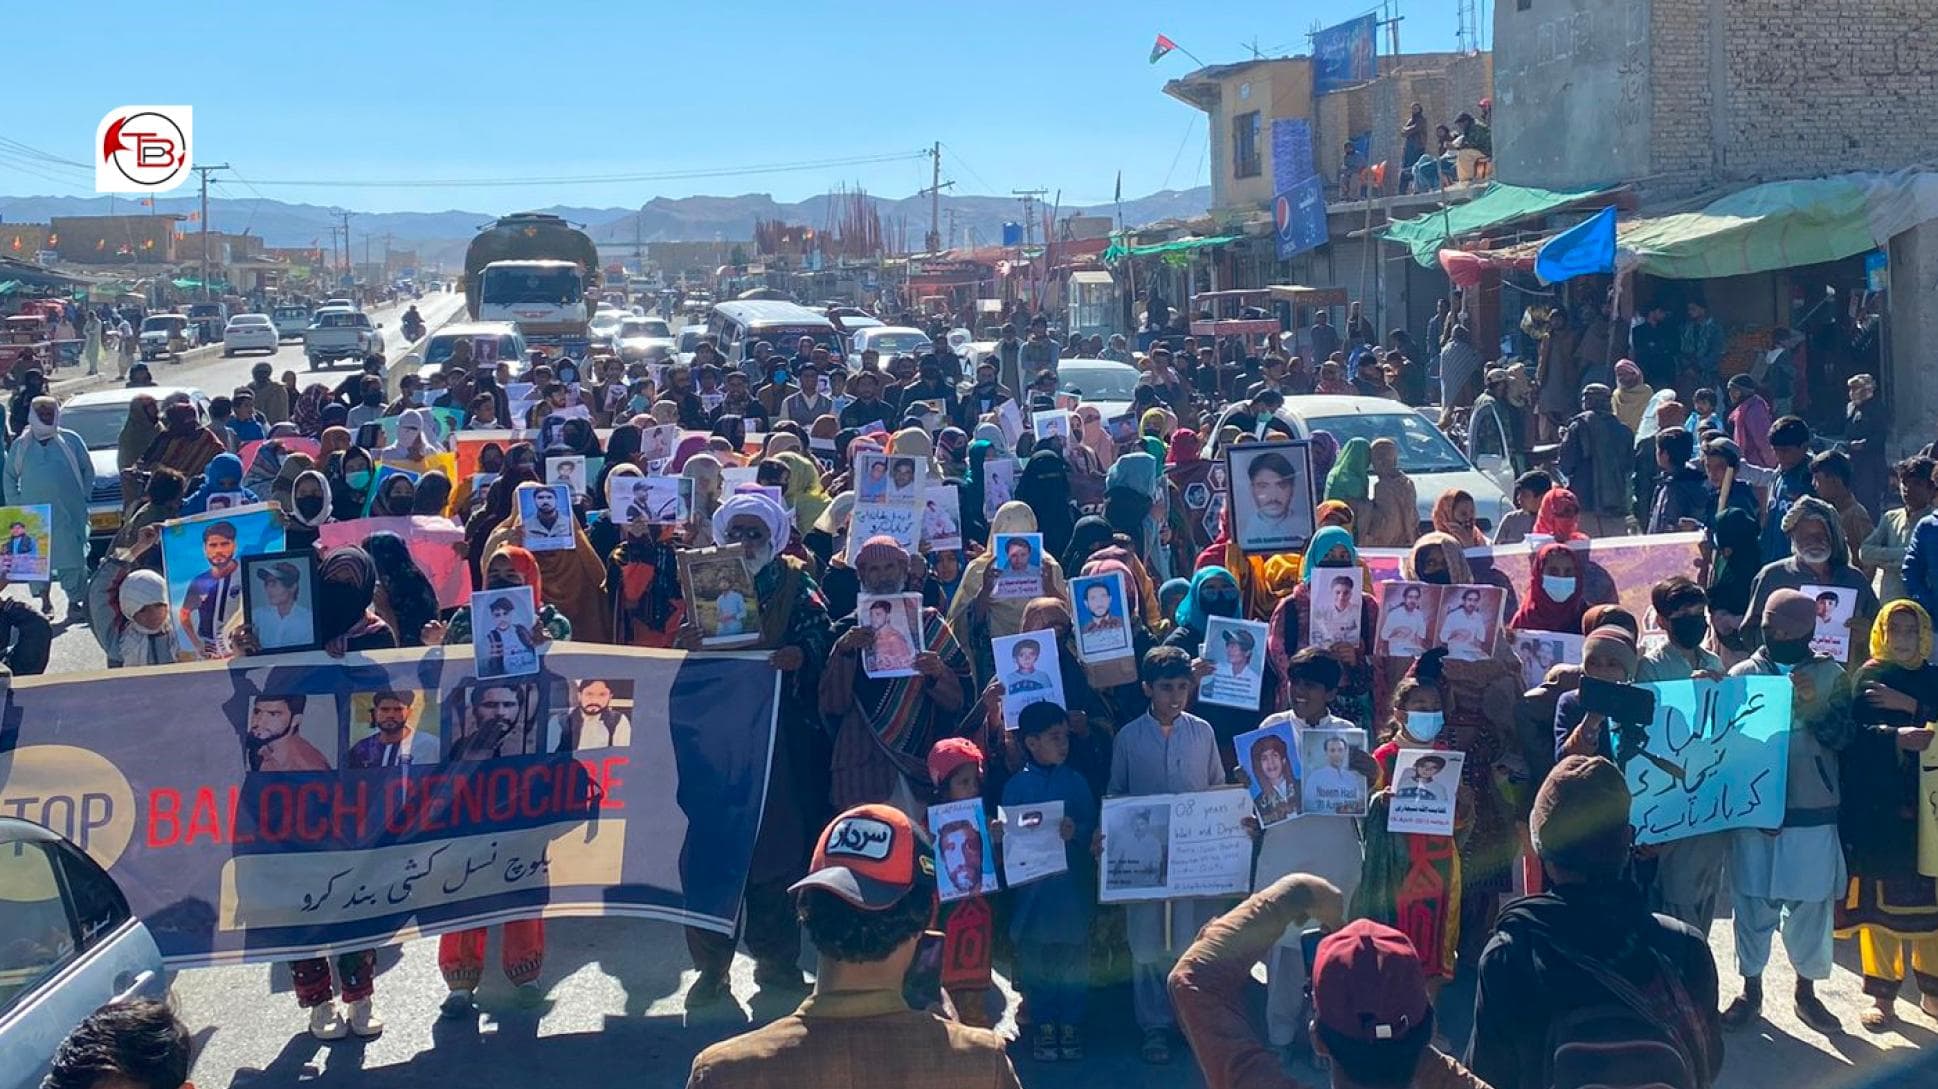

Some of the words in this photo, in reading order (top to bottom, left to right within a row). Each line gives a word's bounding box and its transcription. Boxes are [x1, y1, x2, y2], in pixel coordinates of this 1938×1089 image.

[146, 780, 368, 849] BALOCH
[384, 756, 630, 838] GENOCIDE
[1175, 799, 1196, 818] 08
[829, 822, 887, 851] سردار
[386, 843, 451, 905] کشی
[442, 841, 498, 894] نسل
[503, 848, 551, 882] بلوچ
[300, 867, 354, 912] کرو
[342, 884, 376, 910] بند
